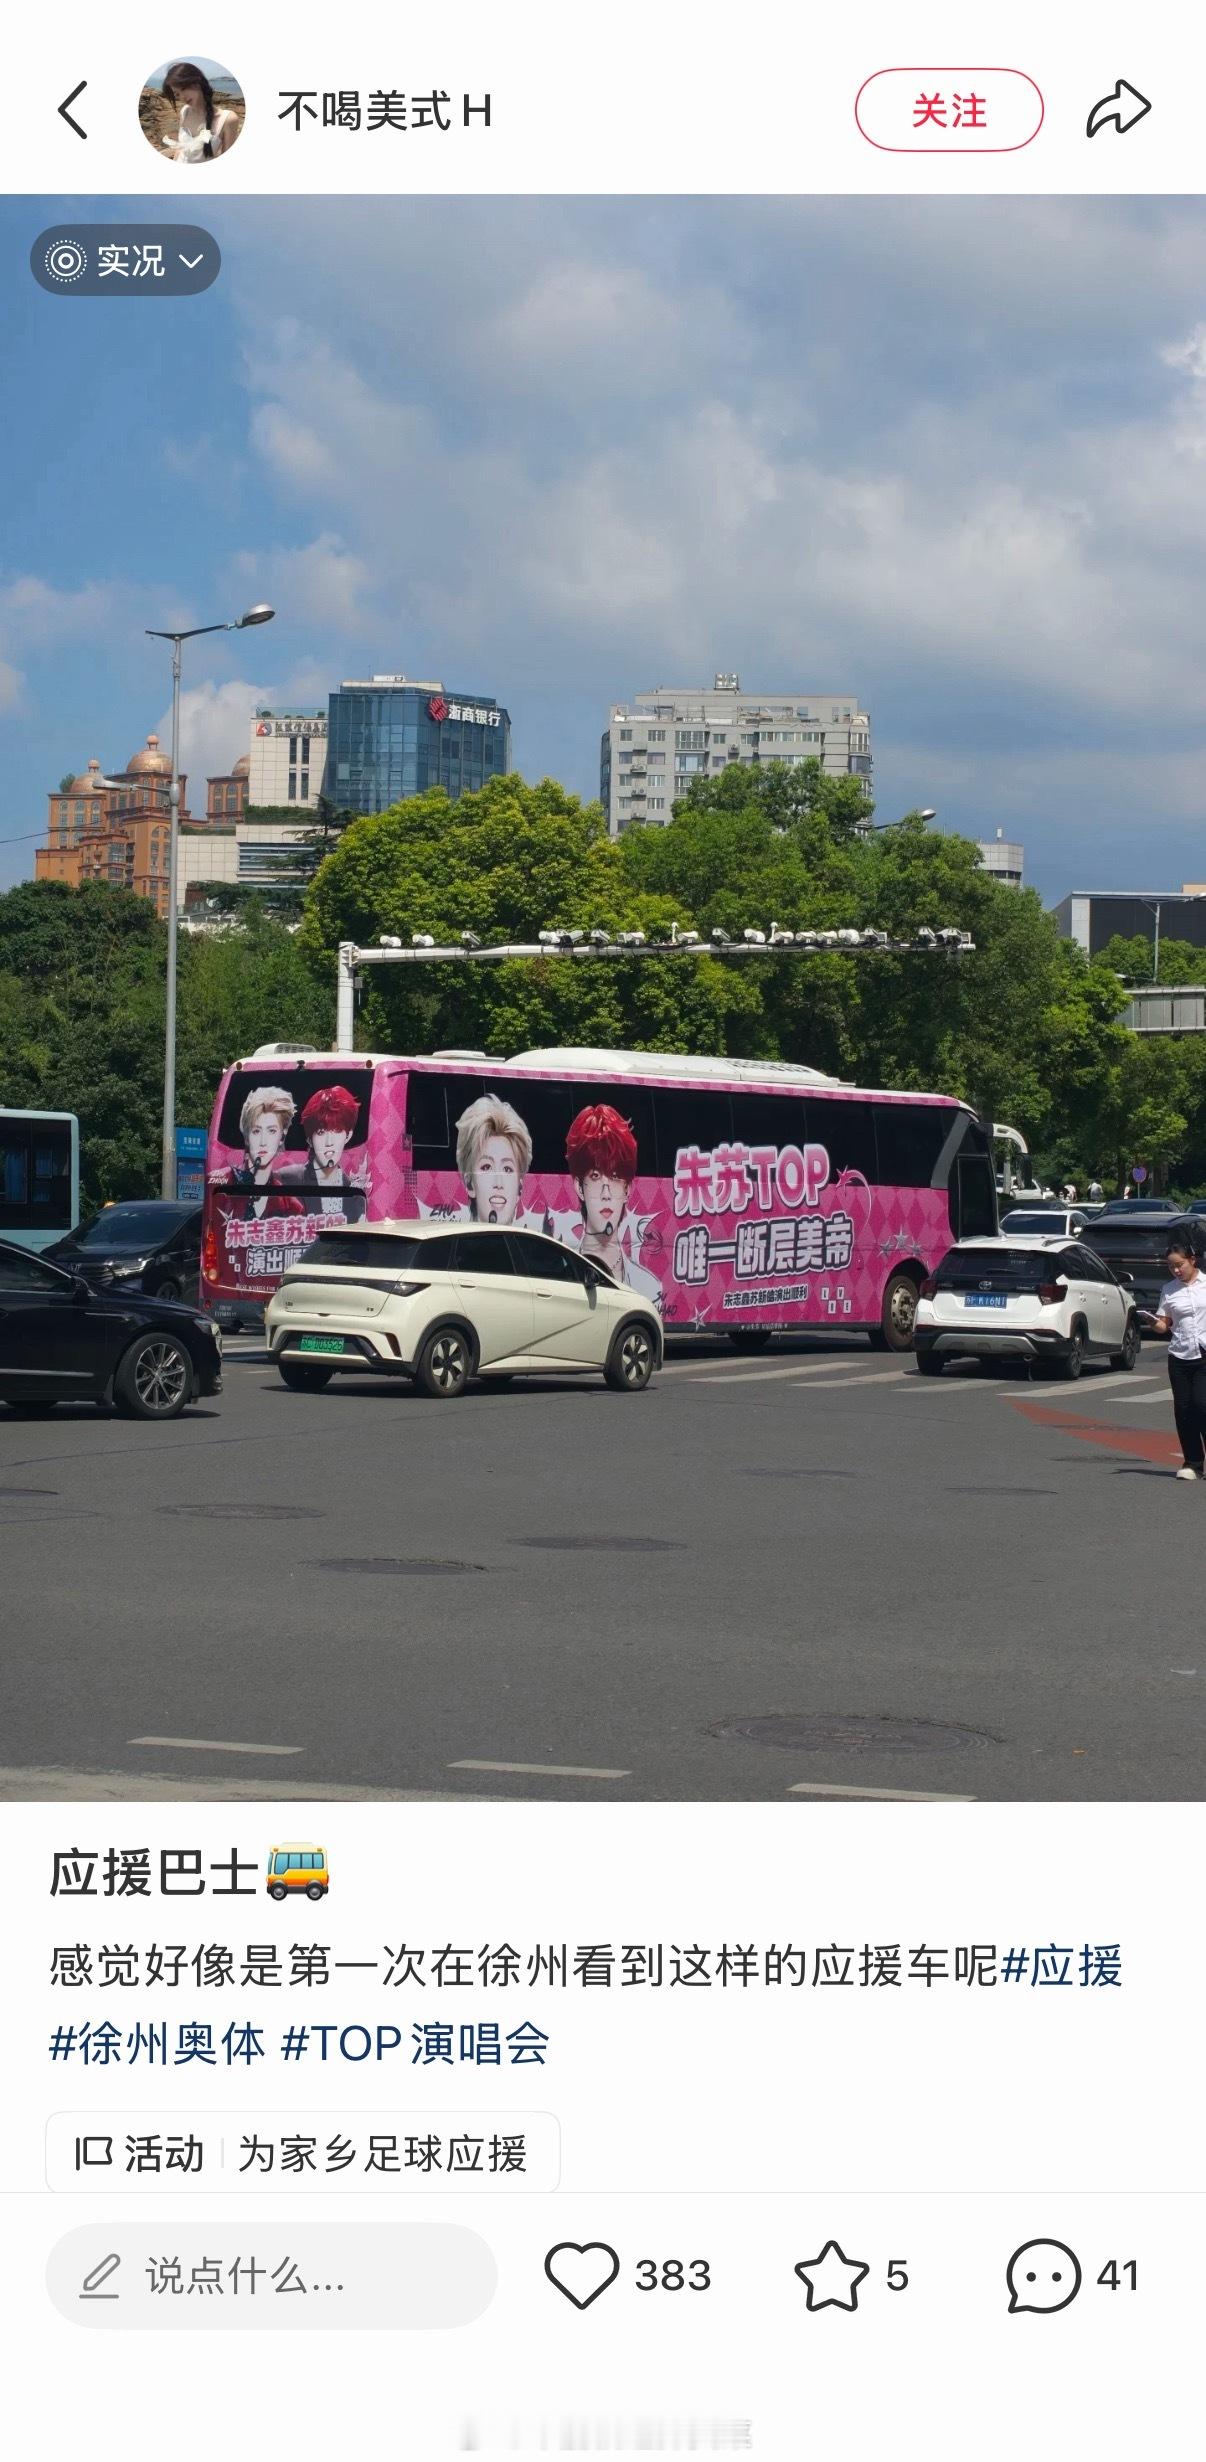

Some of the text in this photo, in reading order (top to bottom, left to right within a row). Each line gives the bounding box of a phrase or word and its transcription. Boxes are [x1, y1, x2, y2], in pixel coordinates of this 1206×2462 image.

[448, 704, 501, 727] 浙商银行
[675, 1143, 830, 1216] 朱苏TOP
[674, 1210, 854, 1286] 唯一断层美帝
